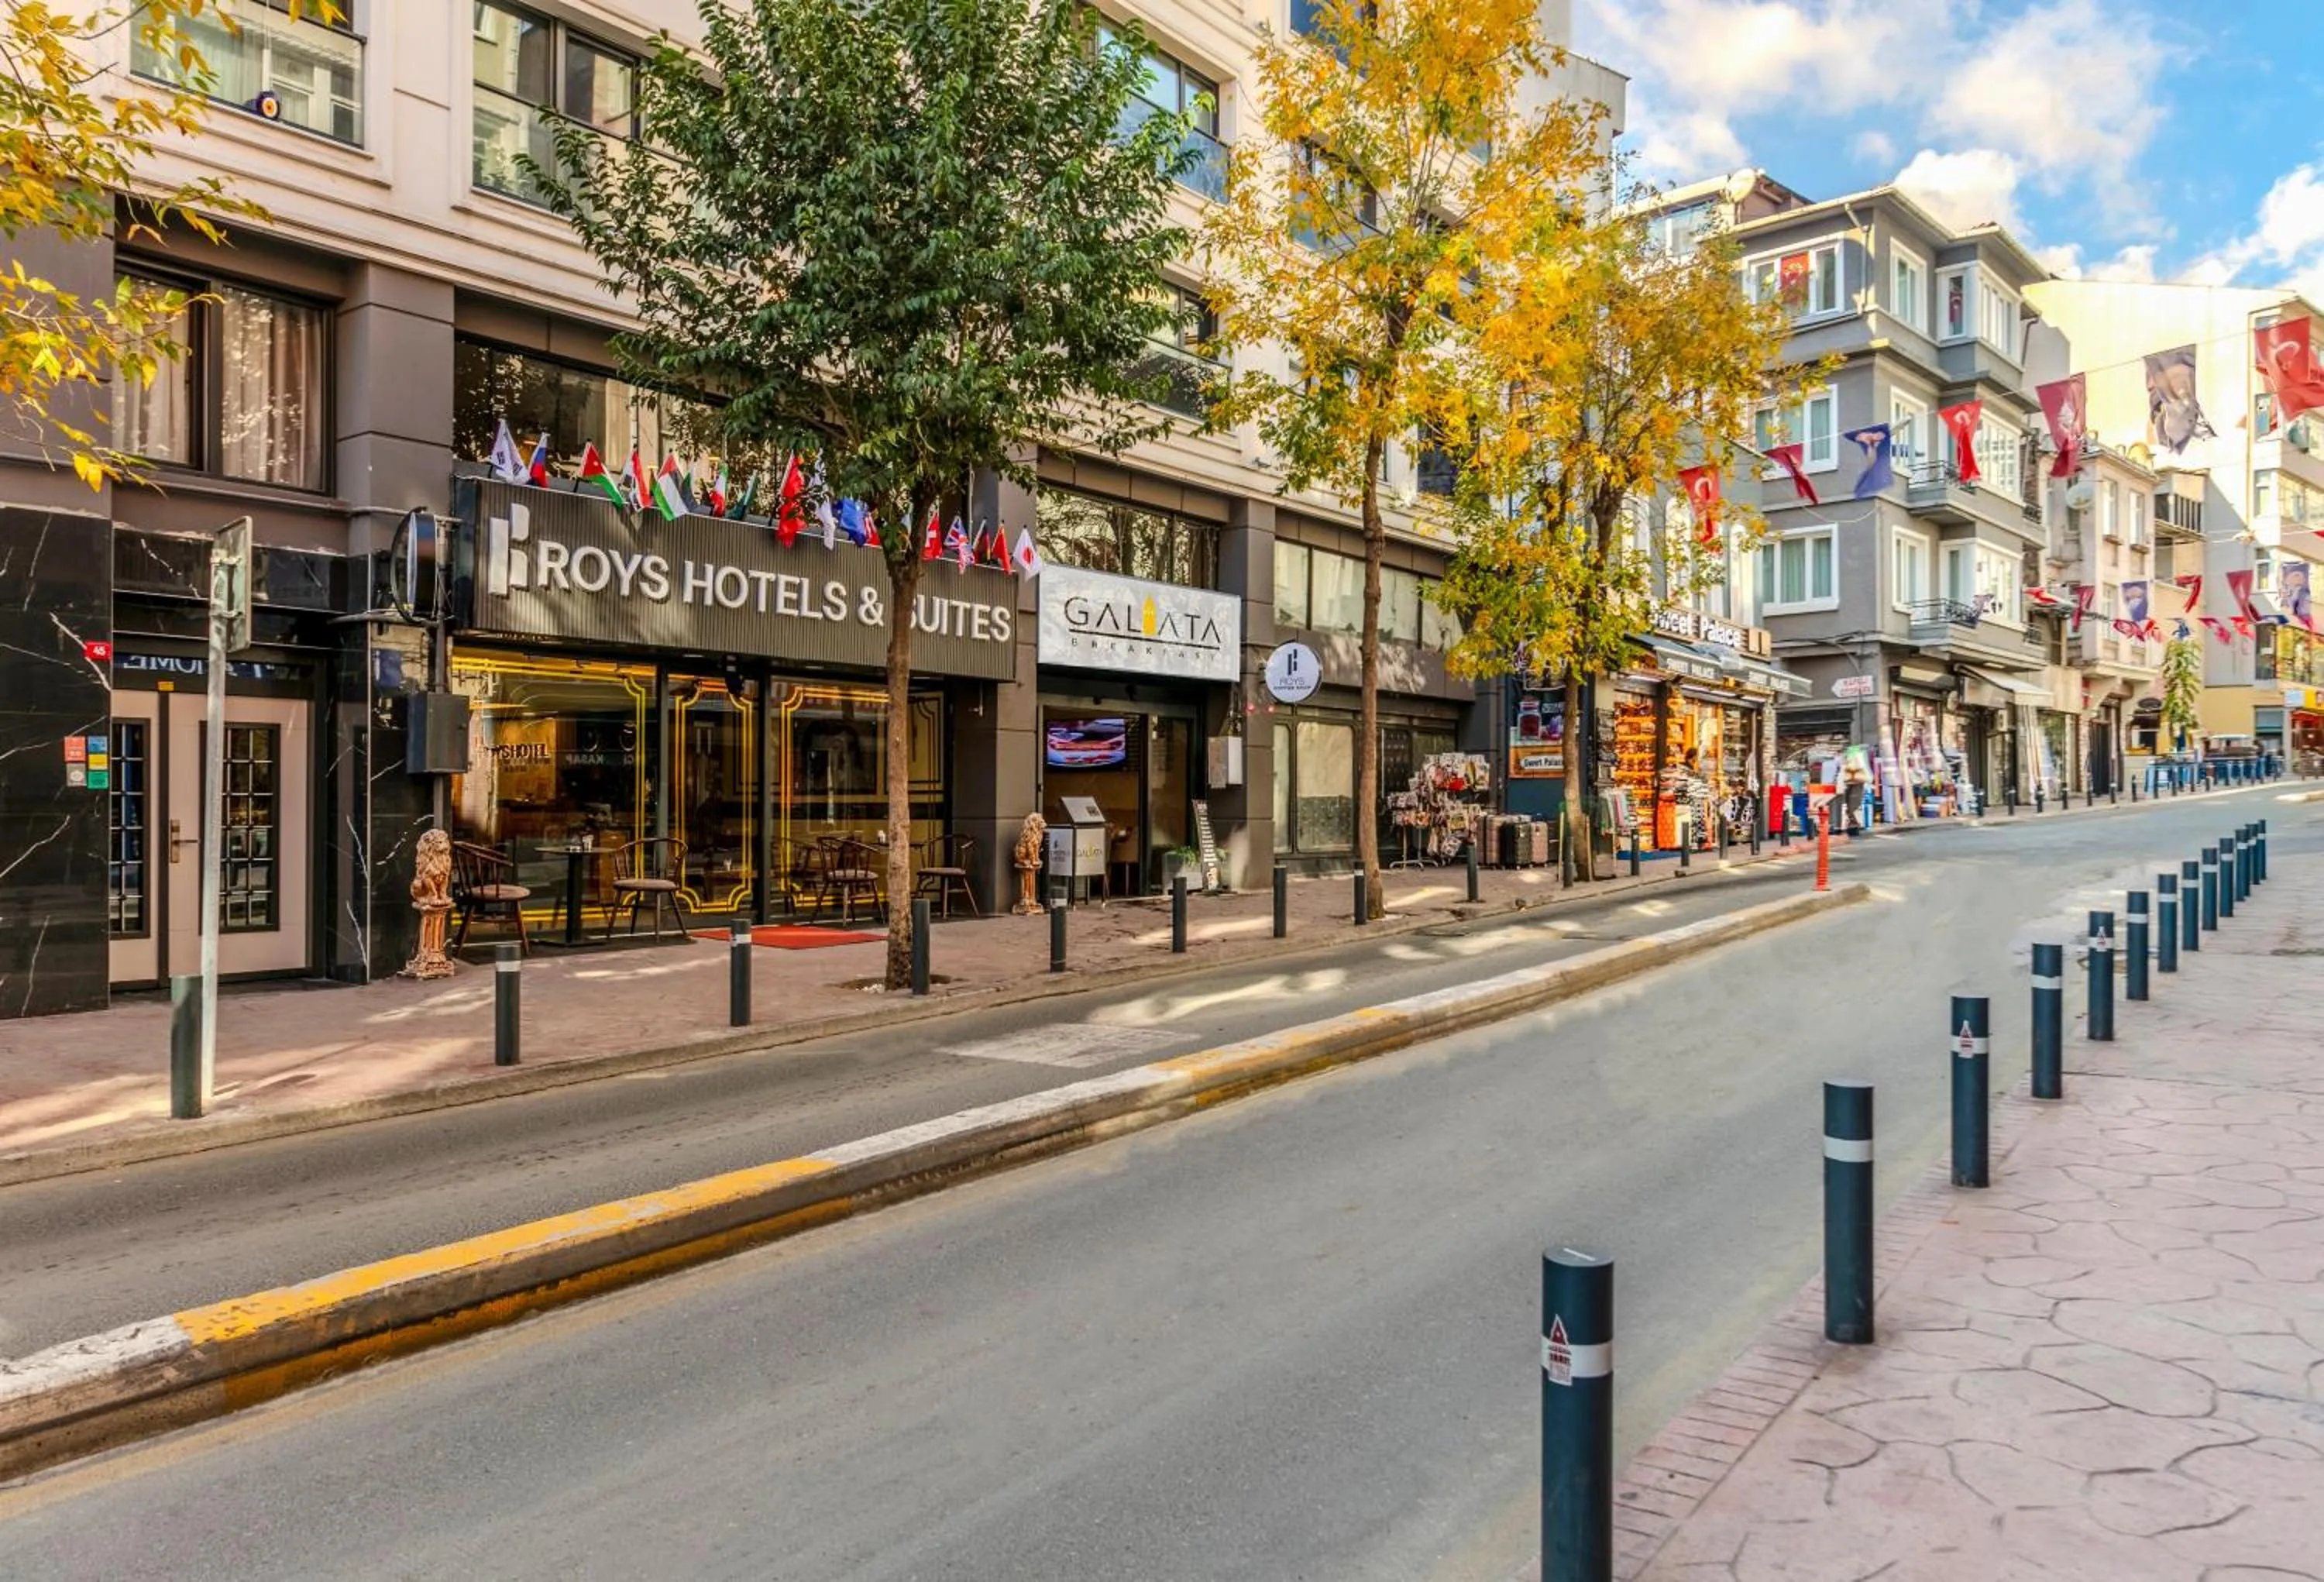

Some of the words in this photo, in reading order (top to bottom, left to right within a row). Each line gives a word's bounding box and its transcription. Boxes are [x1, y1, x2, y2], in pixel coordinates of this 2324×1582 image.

[538, 539, 670, 600] ROYS
[682, 560, 847, 622] HOTELS
[857, 586, 885, 627] &
[1064, 595, 1222, 644] GALATA
[1700, 617, 1741, 648] Palace
[93, 646, 106, 656] 45
[1071, 637, 1216, 661] BREAKFAST
